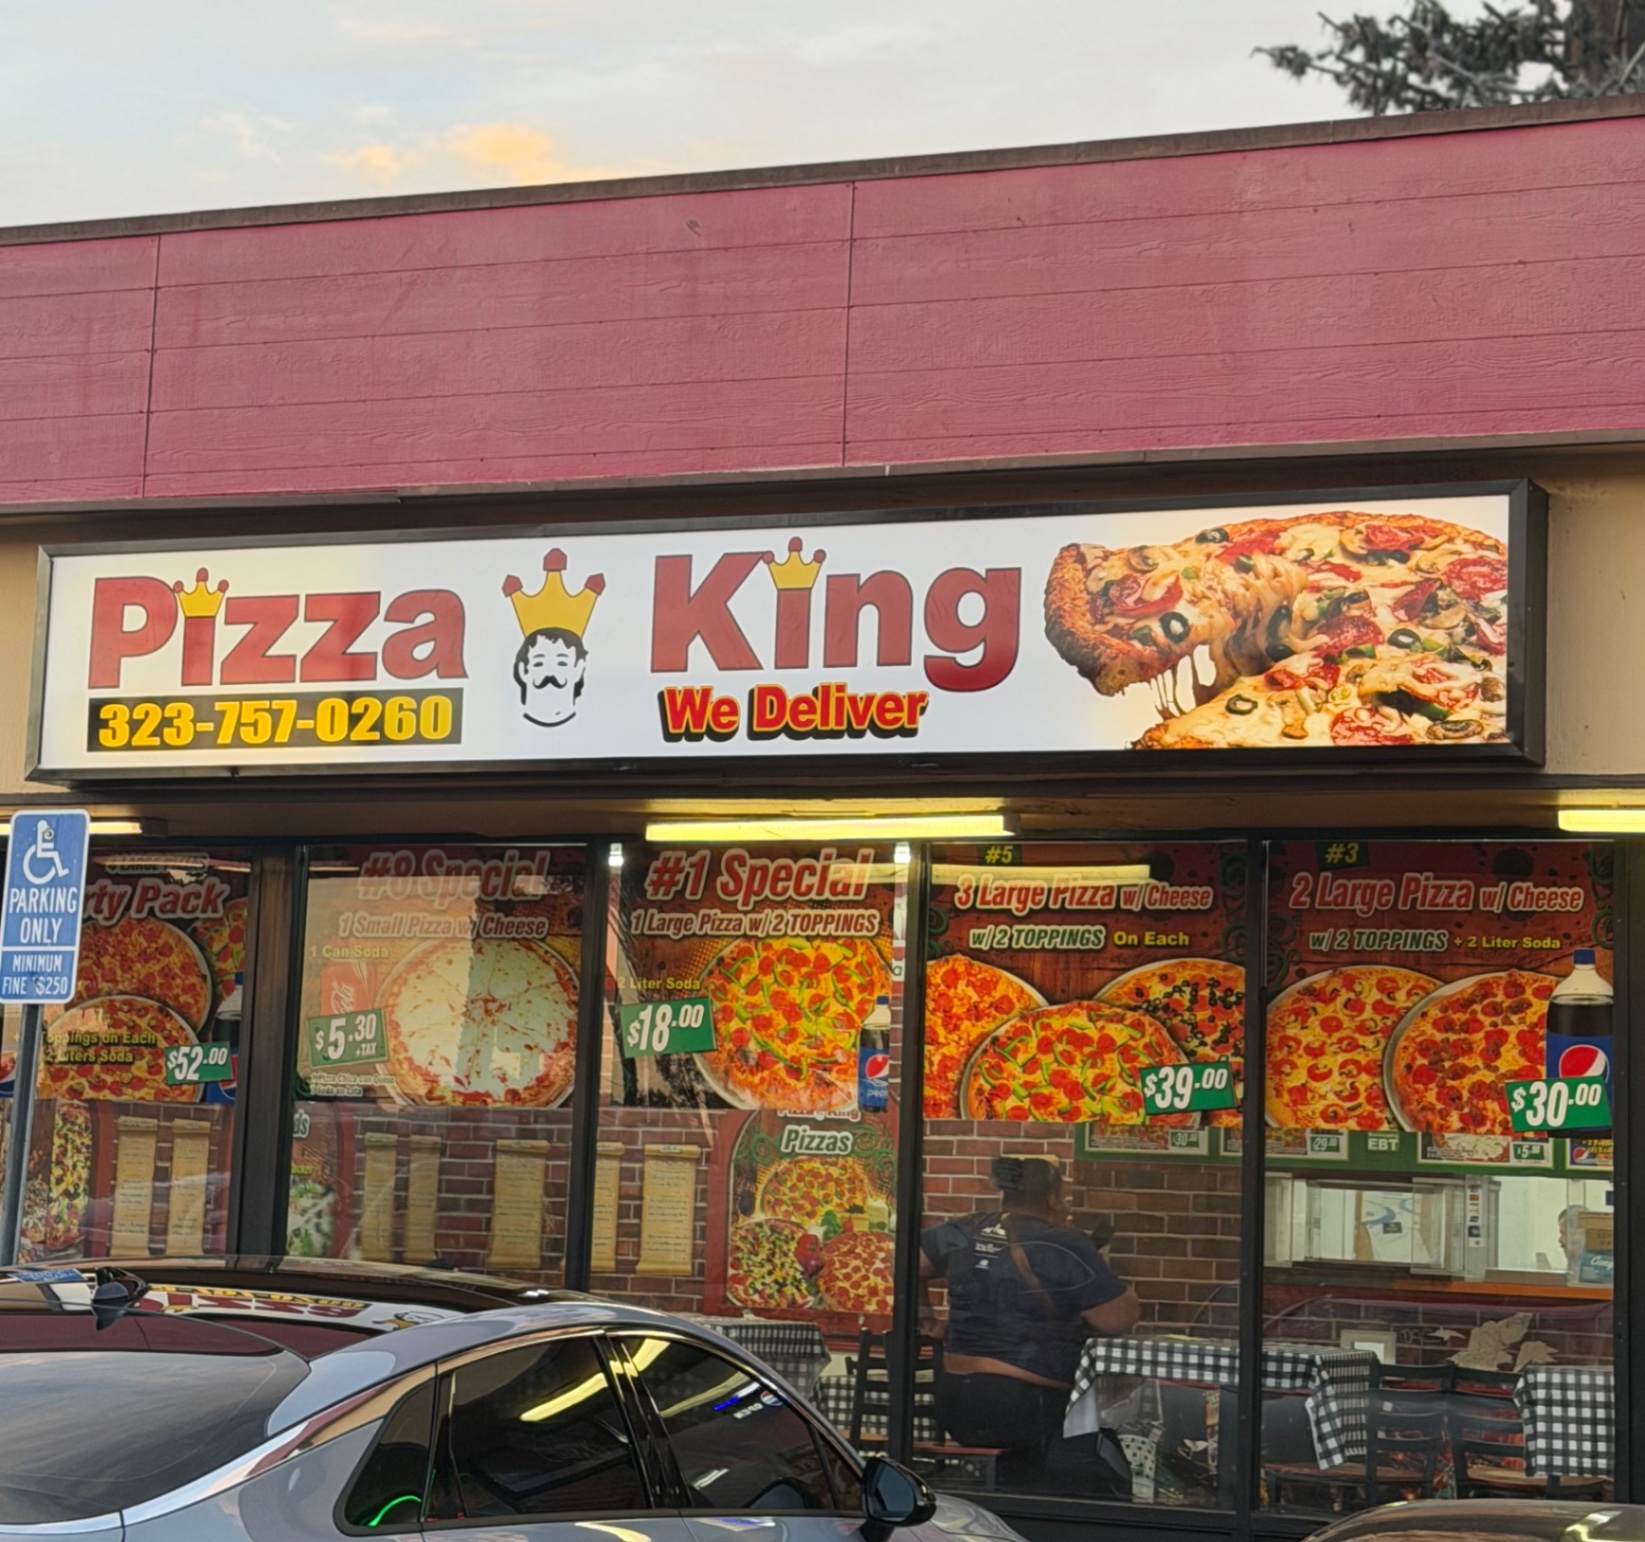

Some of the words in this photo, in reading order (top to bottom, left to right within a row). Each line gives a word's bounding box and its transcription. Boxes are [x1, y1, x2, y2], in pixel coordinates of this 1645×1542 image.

[88, 568, 468, 690] Pizza
[651, 537, 1022, 692] King
[97, 693, 454, 748] 323-757-0260
[661, 685, 741, 740] We
[750, 682, 928, 738] Deliver
[985, 846, 1013, 864] #5
[1325, 843, 1360, 864] #3
[358, 851, 416, 899] #8
[418, 850, 549, 909] Special
[644, 850, 709, 900] #1
[716, 848, 874, 909] Special
[9, 886, 79, 914] PARKING
[85, 879, 131, 926] rty
[131, 878, 229, 919] Pack
[955, 873, 976, 909] 3
[977, 874, 1045, 916] Large
[1049, 874, 1116, 910] Pizza
[1119, 885, 1144, 912] w/
[1146, 883, 1213, 911] Cheese
[1290, 872, 1314, 909] 2
[1315, 873, 1395, 917] Large
[1398, 873, 1474, 911] Pizza
[1479, 883, 1506, 913] w/
[1507, 882, 1584, 912] Cheese
[20, 917, 62, 944] ONLY
[339, 913, 353, 938] 1
[354, 912, 402, 938] Small
[404, 912, 453, 937] Pizza
[479, 912, 549, 938] Cheese
[631, 909, 645, 935] 1
[646, 909, 698, 939] Large
[699, 909, 743, 935] Pizza
[746, 909, 769, 937] w/
[770, 909, 788, 935] 2
[788, 909, 880, 936] TOPPINGS
[970, 926, 993, 950] w/
[994, 926, 1012, 949] 2
[1012, 925, 1106, 949] TOPPINGS
[1113, 932, 1139, 946] On
[1144, 931, 1190, 946] Each
[322, 945, 351, 958] Can
[354, 945, 389, 958] Soda
[1310, 929, 1332, 952] w/
[1333, 930, 1351, 951] 2
[1352, 930, 1449, 952] TOPPINGS
[1453, 937, 1463, 947] +
[1468, 936, 1477, 948] 2
[1482, 936, 1519, 949] Liter
[1522, 936, 1561, 949] Soda
[13, 954, 62, 972] MINIMUM
[2, 976, 27, 995] FINE
[36, 976, 68, 996] $250
[617, 977, 626, 990] 2
[629, 977, 664, 990] Liter
[666, 977, 701, 990] Soda
[123, 1031, 157, 1045] Each
[315, 1013, 377, 1060] $5.30
[627, 1003, 705, 1052] $18.00
[100, 1050, 133, 1063] Soda
[167, 1046, 228, 1080] $52.00
[1143, 1066, 1228, 1109] $39.00
[1510, 1081, 1602, 1127] $30.00
[782, 1125, 853, 1154] Pizzas
[1367, 1138, 1399, 1150] EBT
